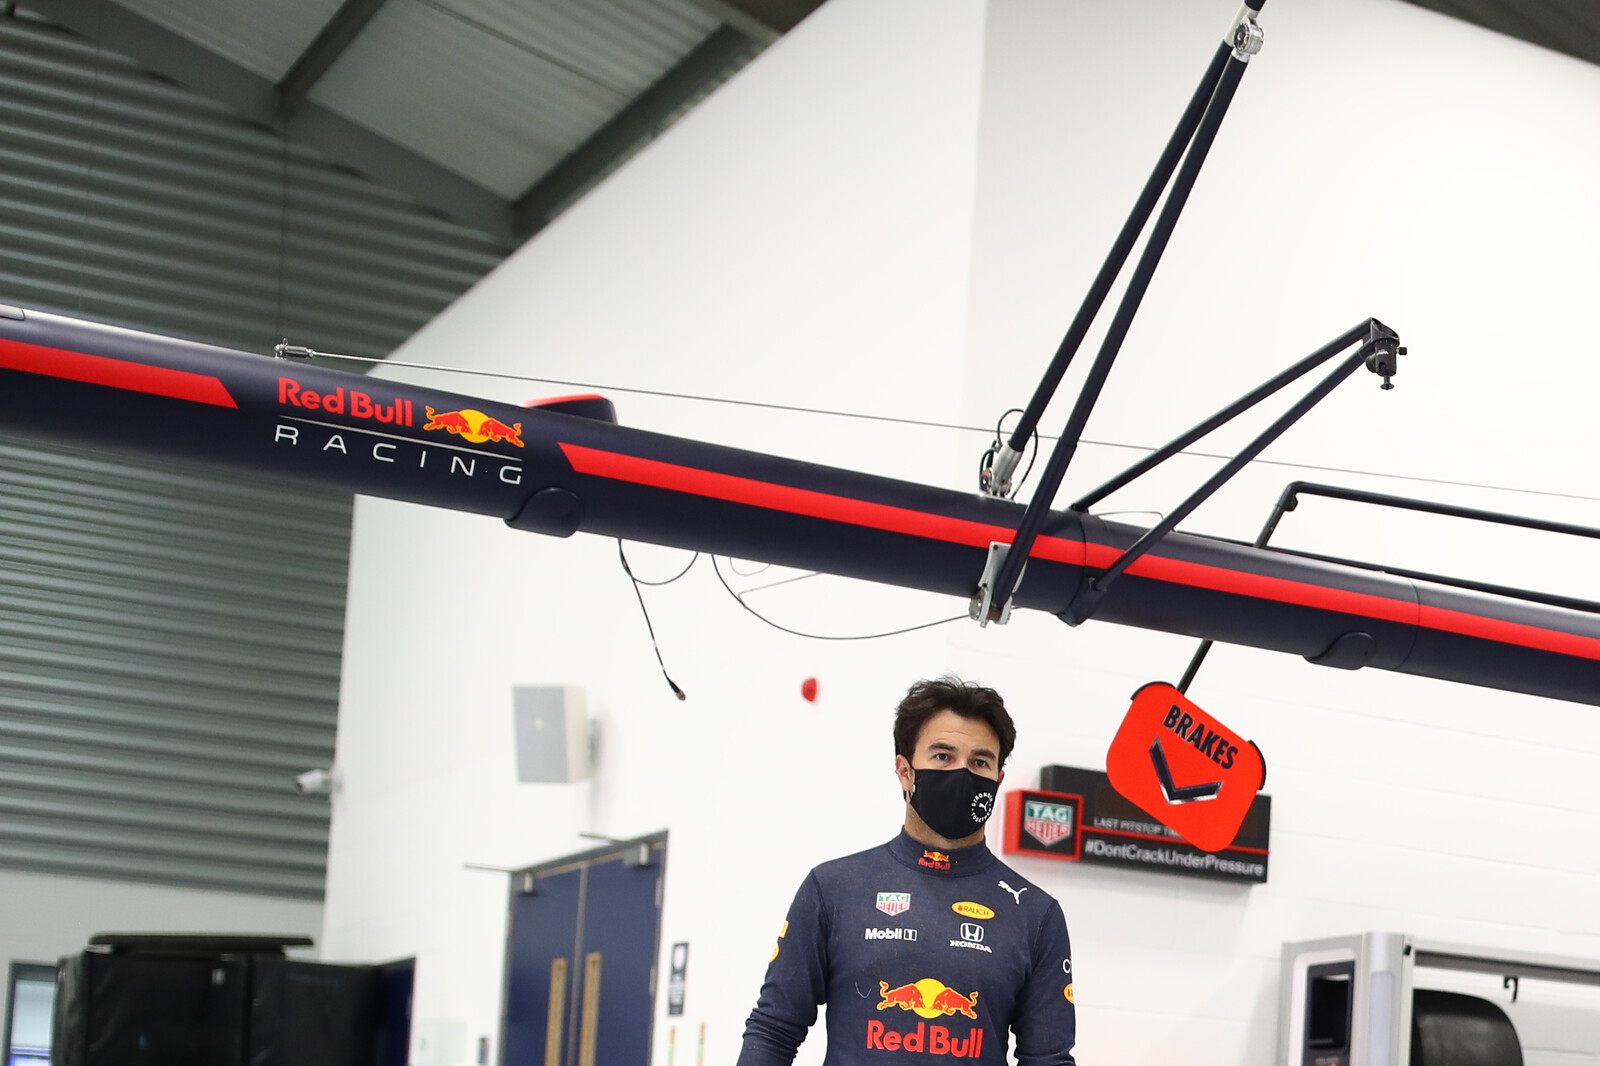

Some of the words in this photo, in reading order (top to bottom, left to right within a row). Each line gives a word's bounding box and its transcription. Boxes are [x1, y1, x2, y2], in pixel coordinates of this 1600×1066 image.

[278, 377, 345, 415] Red
[350, 390, 413, 428] Bull
[274, 424, 523, 485] RACING
[1163, 704, 1239, 770] BRAKES
[1029, 803, 1069, 822] TAG
[1027, 820, 1070, 841] HEUER
[1094, 817, 1120, 830] LAST
[1120, 819, 1162, 836] PITSTOP
[918, 857, 935, 869] Red
[935, 860, 952, 871] Bull
[1085, 839, 1265, 876] #DontCrackUnderPressure
[879, 894, 909, 902] TAG
[877, 902, 909, 914] HEUER
[963, 905, 990, 916] RAUCH
[865, 928, 902, 940] Mobil
[949, 940, 993, 953] HONDA
[866, 1019, 925, 1053] Red
[929, 1025, 984, 1058] Bull
